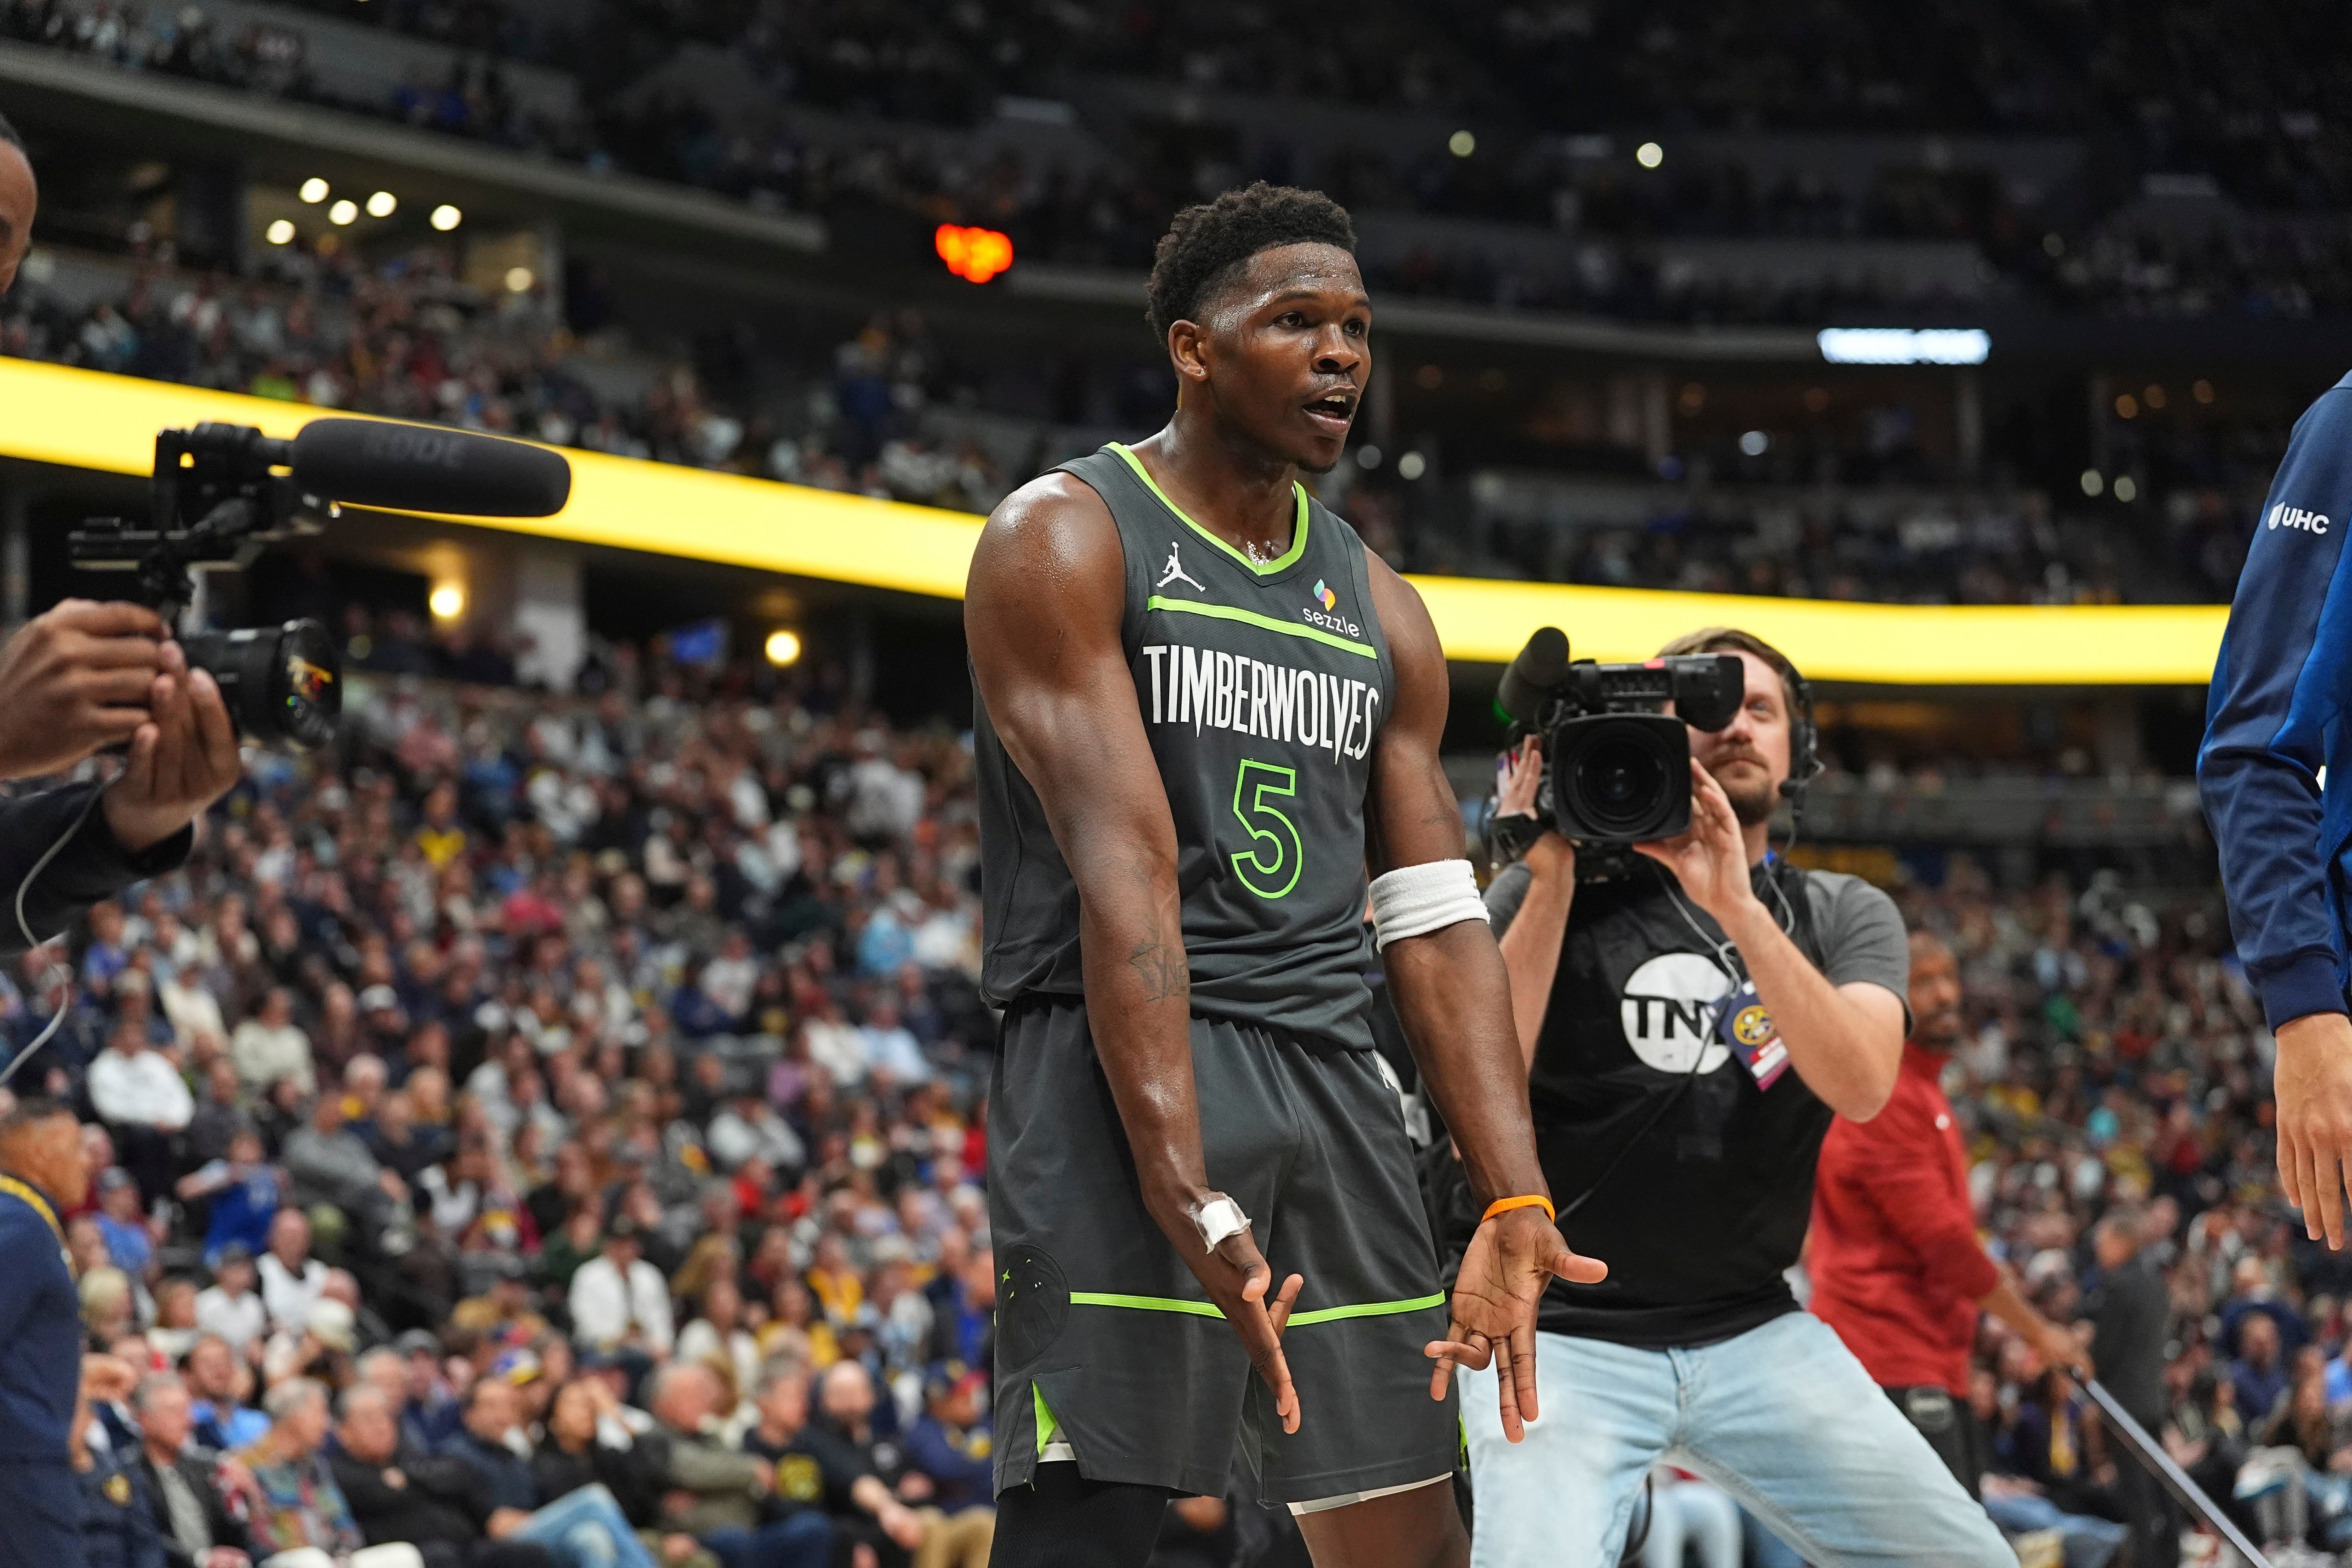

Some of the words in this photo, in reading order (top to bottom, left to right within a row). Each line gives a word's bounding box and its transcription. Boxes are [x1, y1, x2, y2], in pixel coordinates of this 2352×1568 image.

[2282, 506, 2330, 535] UHC
[1303, 608, 1359, 637] sezzle
[1142, 644, 1379, 765] TIMBERWOLVES
[1231, 758, 1303, 899] 5
